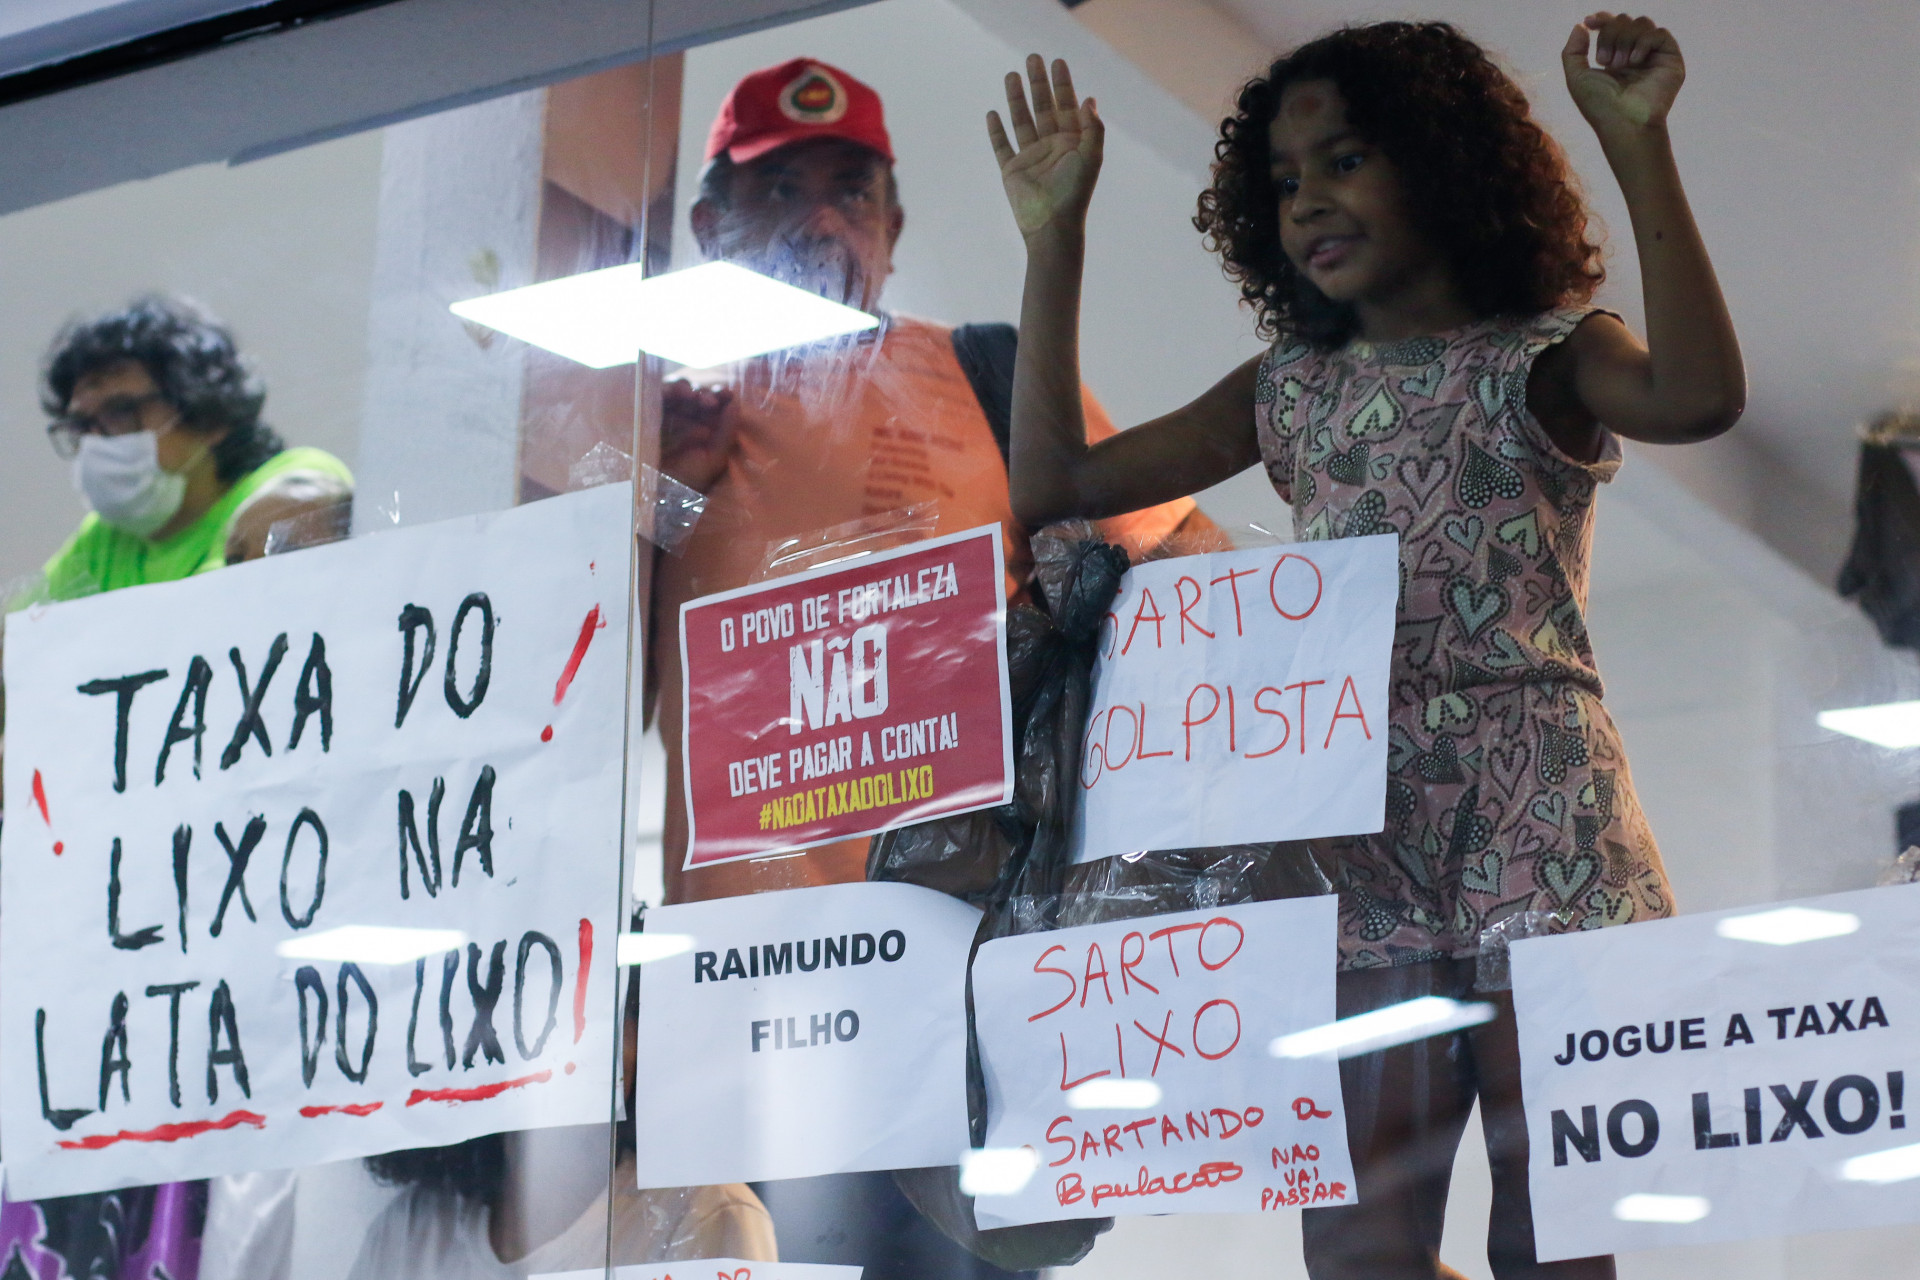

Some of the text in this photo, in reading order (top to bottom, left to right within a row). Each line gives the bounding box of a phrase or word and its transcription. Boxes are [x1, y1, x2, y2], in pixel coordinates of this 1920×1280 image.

[720, 562, 959, 653] O POVO DE FORTALEZA
[77, 632, 334, 793] TAXA
[395, 592, 495, 729] DO
[789, 623, 889, 736] NÃO
[728, 712, 959, 798] DEVE PAGAR A CONTA!
[1080, 675, 1372, 790] GOLPISTA
[108, 807, 329, 954] LIXO
[398, 764, 496, 900] NA
[694, 929, 906, 983] RAIMUNDO
[1028, 916, 1244, 1023] SARTO
[36, 979, 251, 1131] LATA
[294, 962, 378, 1089] DO
[751, 1009, 860, 1052] FILHO
[1060, 998, 1241, 1091] LIXO
[1554, 996, 1889, 1066] JOGUE A TAXA
[1045, 1106, 1265, 1168] SARTANDO
[1551, 1070, 1906, 1167] NO LIXO!
[1261, 1182, 1347, 1211] PASSAR
